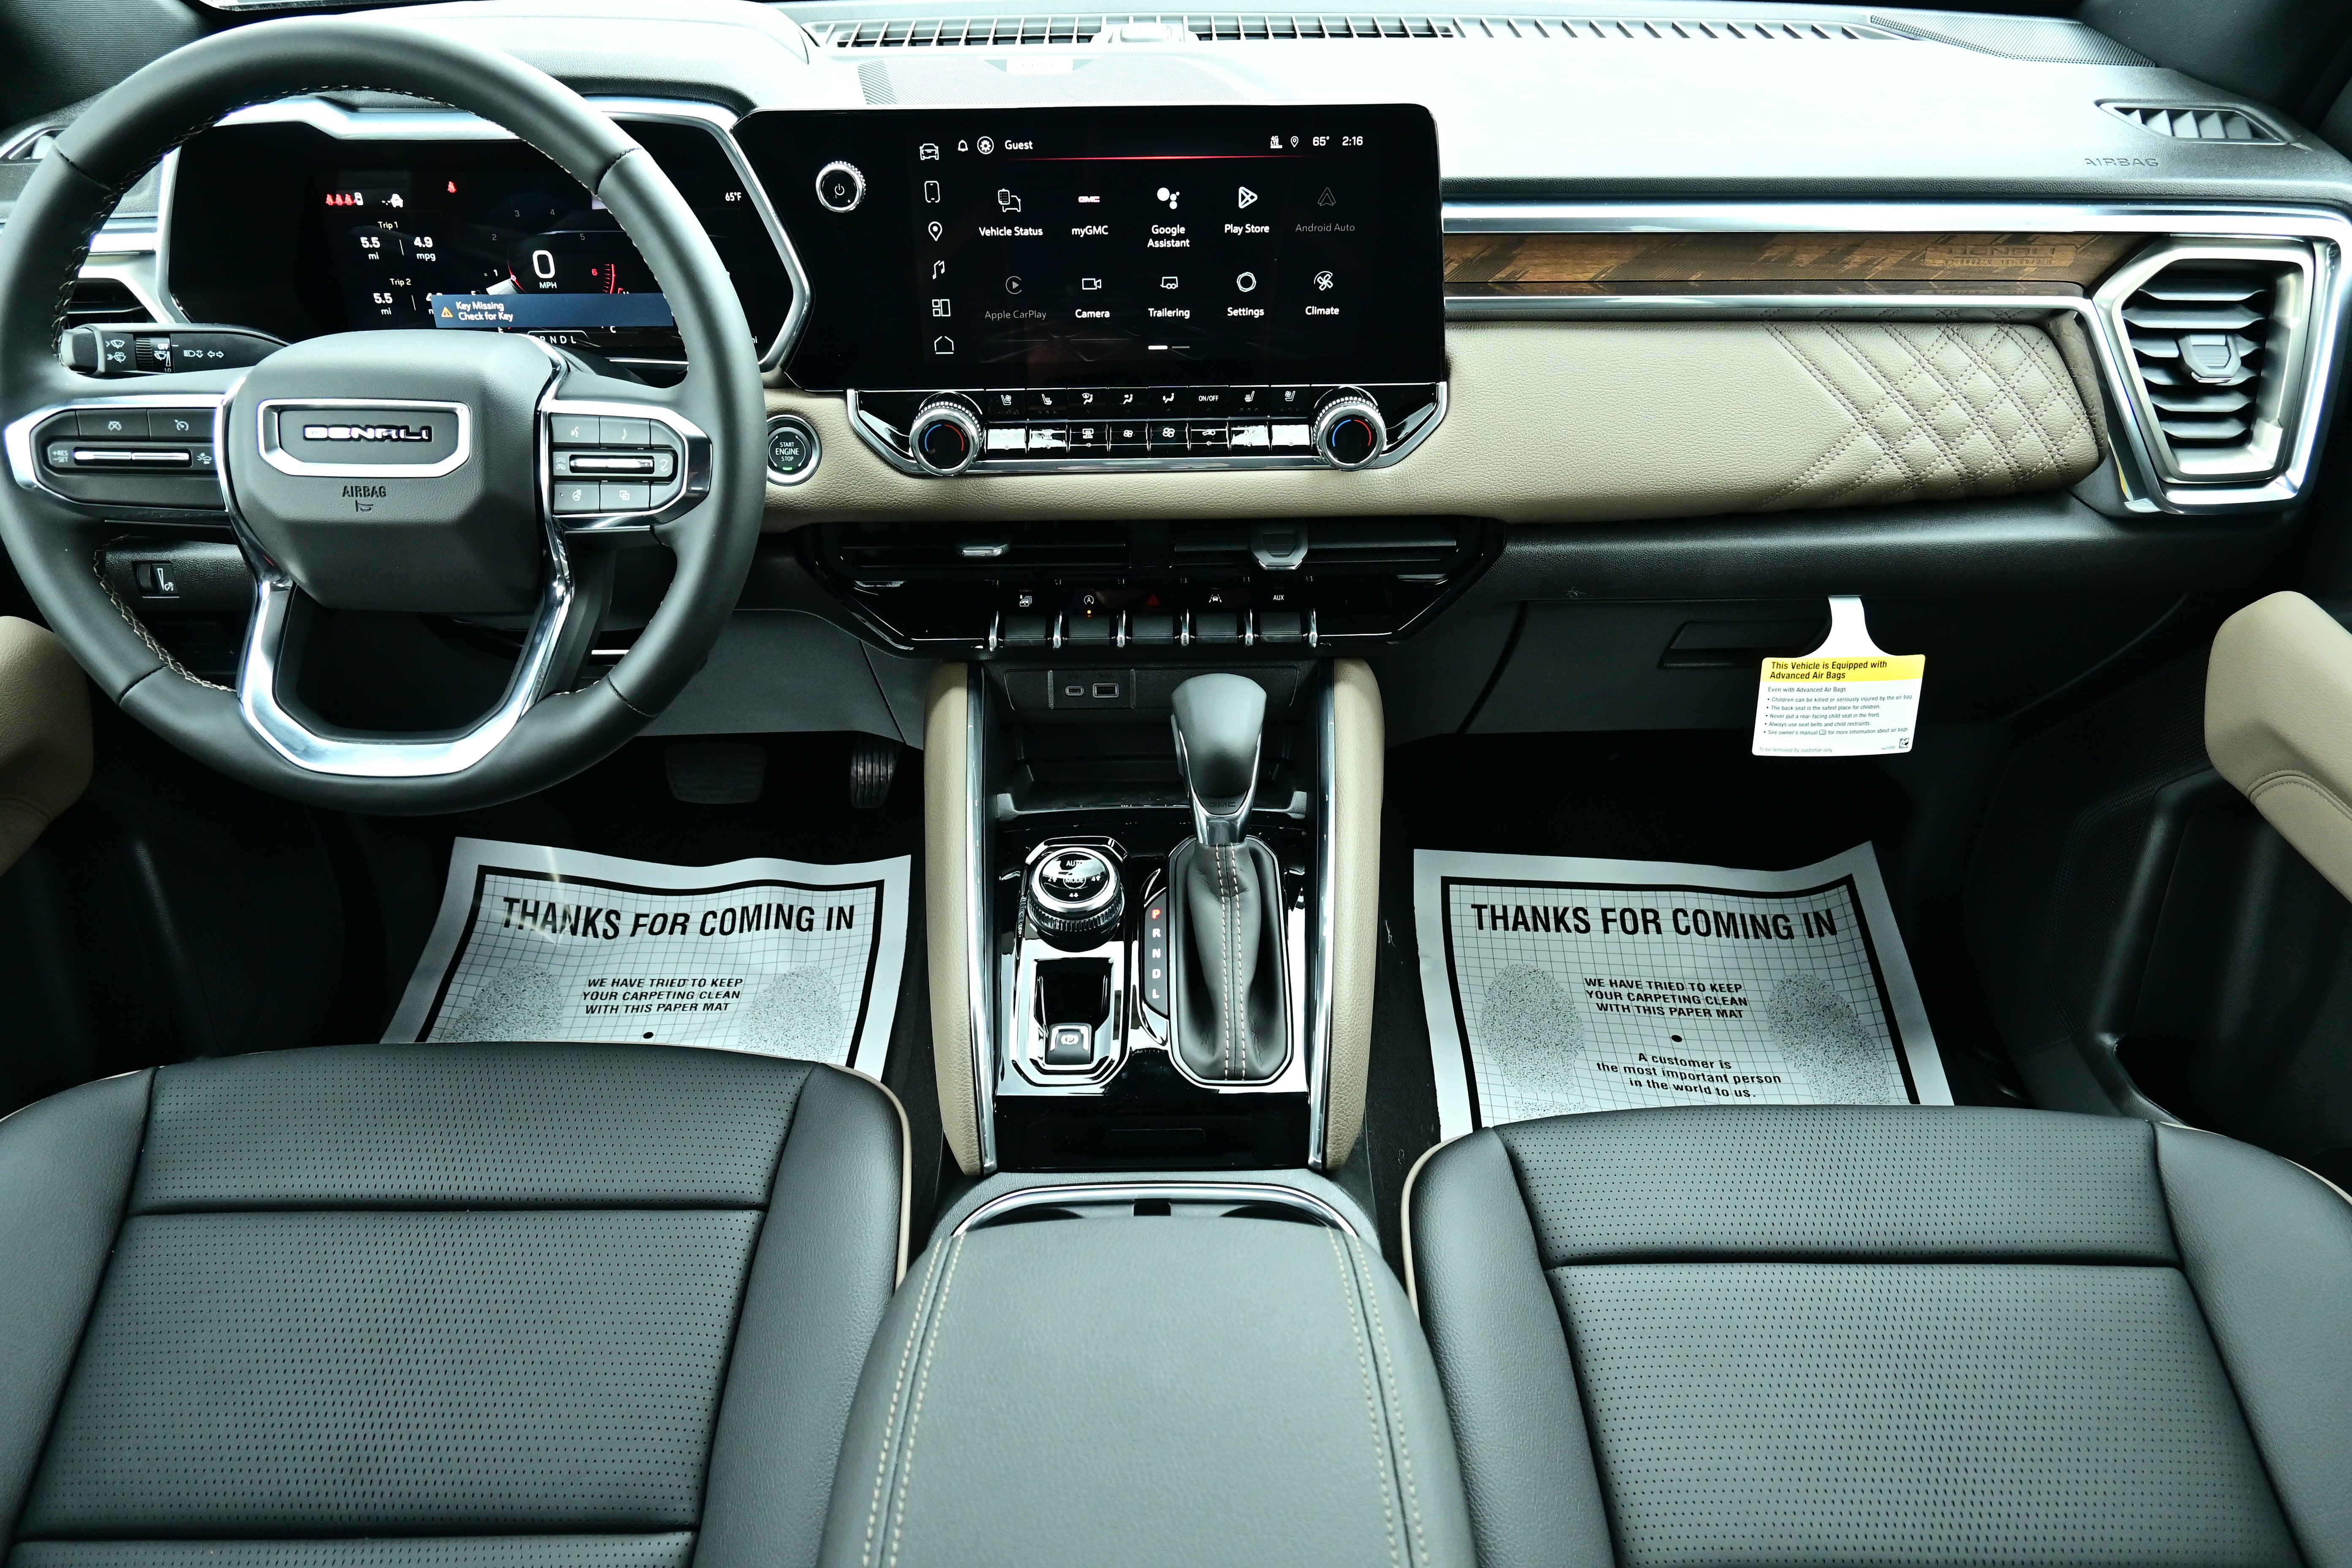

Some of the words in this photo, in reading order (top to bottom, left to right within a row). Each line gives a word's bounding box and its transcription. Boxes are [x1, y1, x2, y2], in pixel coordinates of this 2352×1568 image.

[1004, 140, 1033, 151] Guest
[1313, 136, 1330, 146] 65°
[1342, 136, 1363, 146] 2:16
[2085, 158, 2159, 166] AIRBAG
[725, 192, 742, 201] 65°F
[378, 221, 393, 230] Trip
[1152, 225, 1185, 236] Google
[1225, 224, 1243, 236] Play
[1245, 224, 1270, 233] Store
[1296, 223, 1331, 232] Android
[1334, 223, 1355, 232] Auto
[979, 226, 1012, 236] Vehicle
[1014, 226, 1043, 236] Status
[1072, 226, 1108, 236] myGMC
[360, 237, 380, 248] 5.5
[414, 237, 433, 248] 4.9
[1147, 238, 1190, 248] Assistant
[368, 252, 379, 260] mi
[416, 253, 436, 261] mpg
[532, 250, 555, 278] 0
[389, 278, 404, 286] Trip
[373, 293, 393, 303] 5.5
[381, 307, 392, 315] mi
[455, 301, 471, 312] Key
[472, 301, 504, 312] Missing
[1305, 306, 1339, 316] Climate
[458, 312, 484, 321] Check
[485, 311, 497, 320] for
[498, 312, 514, 322] Key
[985, 310, 1011, 320] Apple
[1013, 310, 1046, 321] CarPlay
[1075, 309, 1110, 318] Camera
[1148, 308, 1190, 319] Trailering
[1227, 307, 1264, 318] Settings
[304, 425, 430, 441] DENALI
[342, 486, 387, 498] AIRBAG
[1832, 661, 1868, 670] Equipped
[1826, 671, 1846, 681] Bags
[502, 896, 621, 940] THANKS
[631, 912, 690, 939] FOR
[699, 903, 814, 938] COMING
[826, 904, 855, 932] IN
[1152, 909, 1160, 919] P
[1471, 904, 1590, 935] THANKS
[1604, 908, 1661, 936] FOR
[1671, 908, 1792, 941] COMING
[1802, 908, 1837, 938] IN
[1152, 928, 1161, 938] R
[1153, 949, 1161, 958] N
[1153, 969, 1160, 978] D
[588, 978, 607, 987] WE
[611, 979, 645, 987] HAVE
[649, 979, 686, 987] TRIED
[691, 979, 706, 987] TO
[710, 979, 743, 987] KEEP
[1584, 978, 1605, 987] WE
[1609, 979, 1643, 989] HAVE
[1646, 981, 1685, 991] TRIED
[1688, 983, 1705, 992] TO
[1710, 983, 1742, 993] KEEP
[583, 991, 618, 1001] YOUR
[623, 991, 695, 1001] CARPETING
[699, 991, 740, 999] CLEAN
[1153, 989, 1159, 999] L
[1586, 991, 1623, 1000] YOUR
[1627, 992, 1701, 1004] CARPETING
[1705, 996, 1748, 1006] CLEAN
[585, 1005, 619, 1014] WITH
[623, 1004, 652, 1013] THIS
[656, 1003, 698, 1012] PAPER
[702, 1003, 730, 1011] MAT
[1596, 1002, 1631, 1013] WITH
[1634, 1005, 1665, 1015] THIS
[1669, 1007, 1712, 1017] PAPER
[1716, 1009, 1744, 1018] MAT
[1639, 1053, 1647, 1062] A
[1652, 1055, 1715, 1068] customer
[1719, 1059, 1732, 1069] is
[1596, 1062, 1619, 1073] the
[1623, 1066, 1657, 1076] most
[1661, 1068, 1729, 1083] important
[1733, 1075, 1781, 1085] person
[1629, 1078, 1642, 1087] in
[1647, 1080, 1668, 1090] the
[1672, 1083, 1712, 1095] world
[1715, 1087, 1729, 1097] to
[1734, 1089, 1756, 1097] us.
